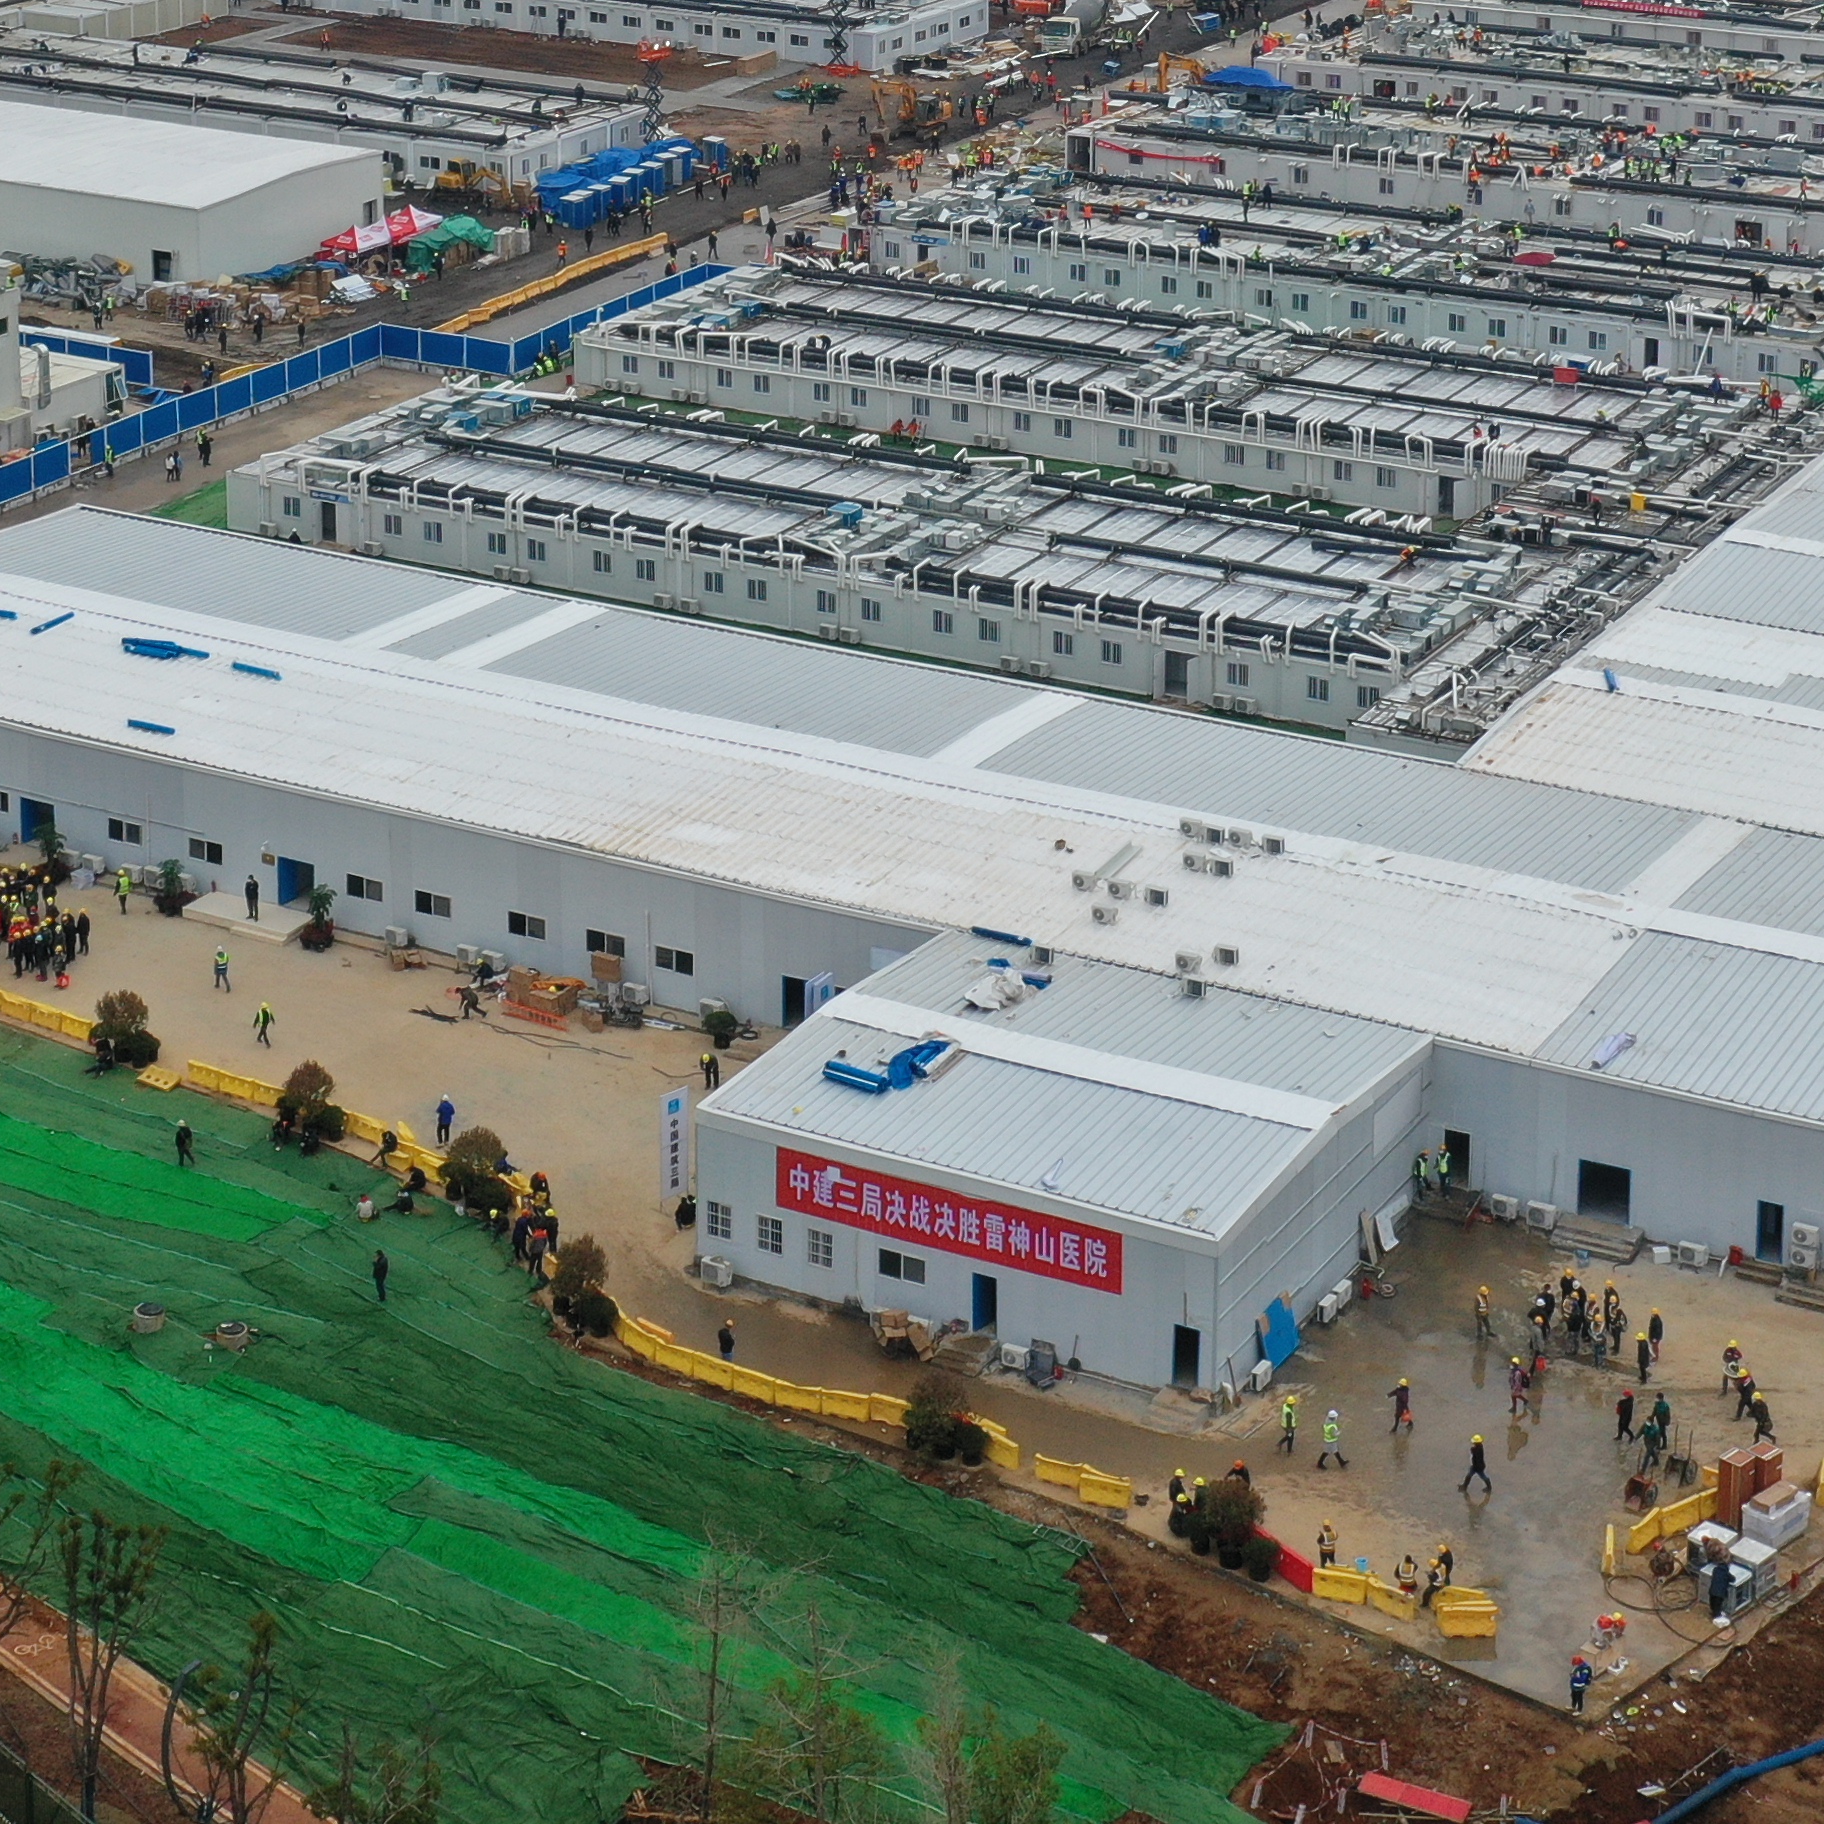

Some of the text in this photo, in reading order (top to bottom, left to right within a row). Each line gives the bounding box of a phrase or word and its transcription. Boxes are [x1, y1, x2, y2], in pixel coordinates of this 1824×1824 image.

[670, 1118, 679, 1189] 中国建筑三局
[788, 1162, 1108, 1279] 中建三局决战决胜雷神山医院
